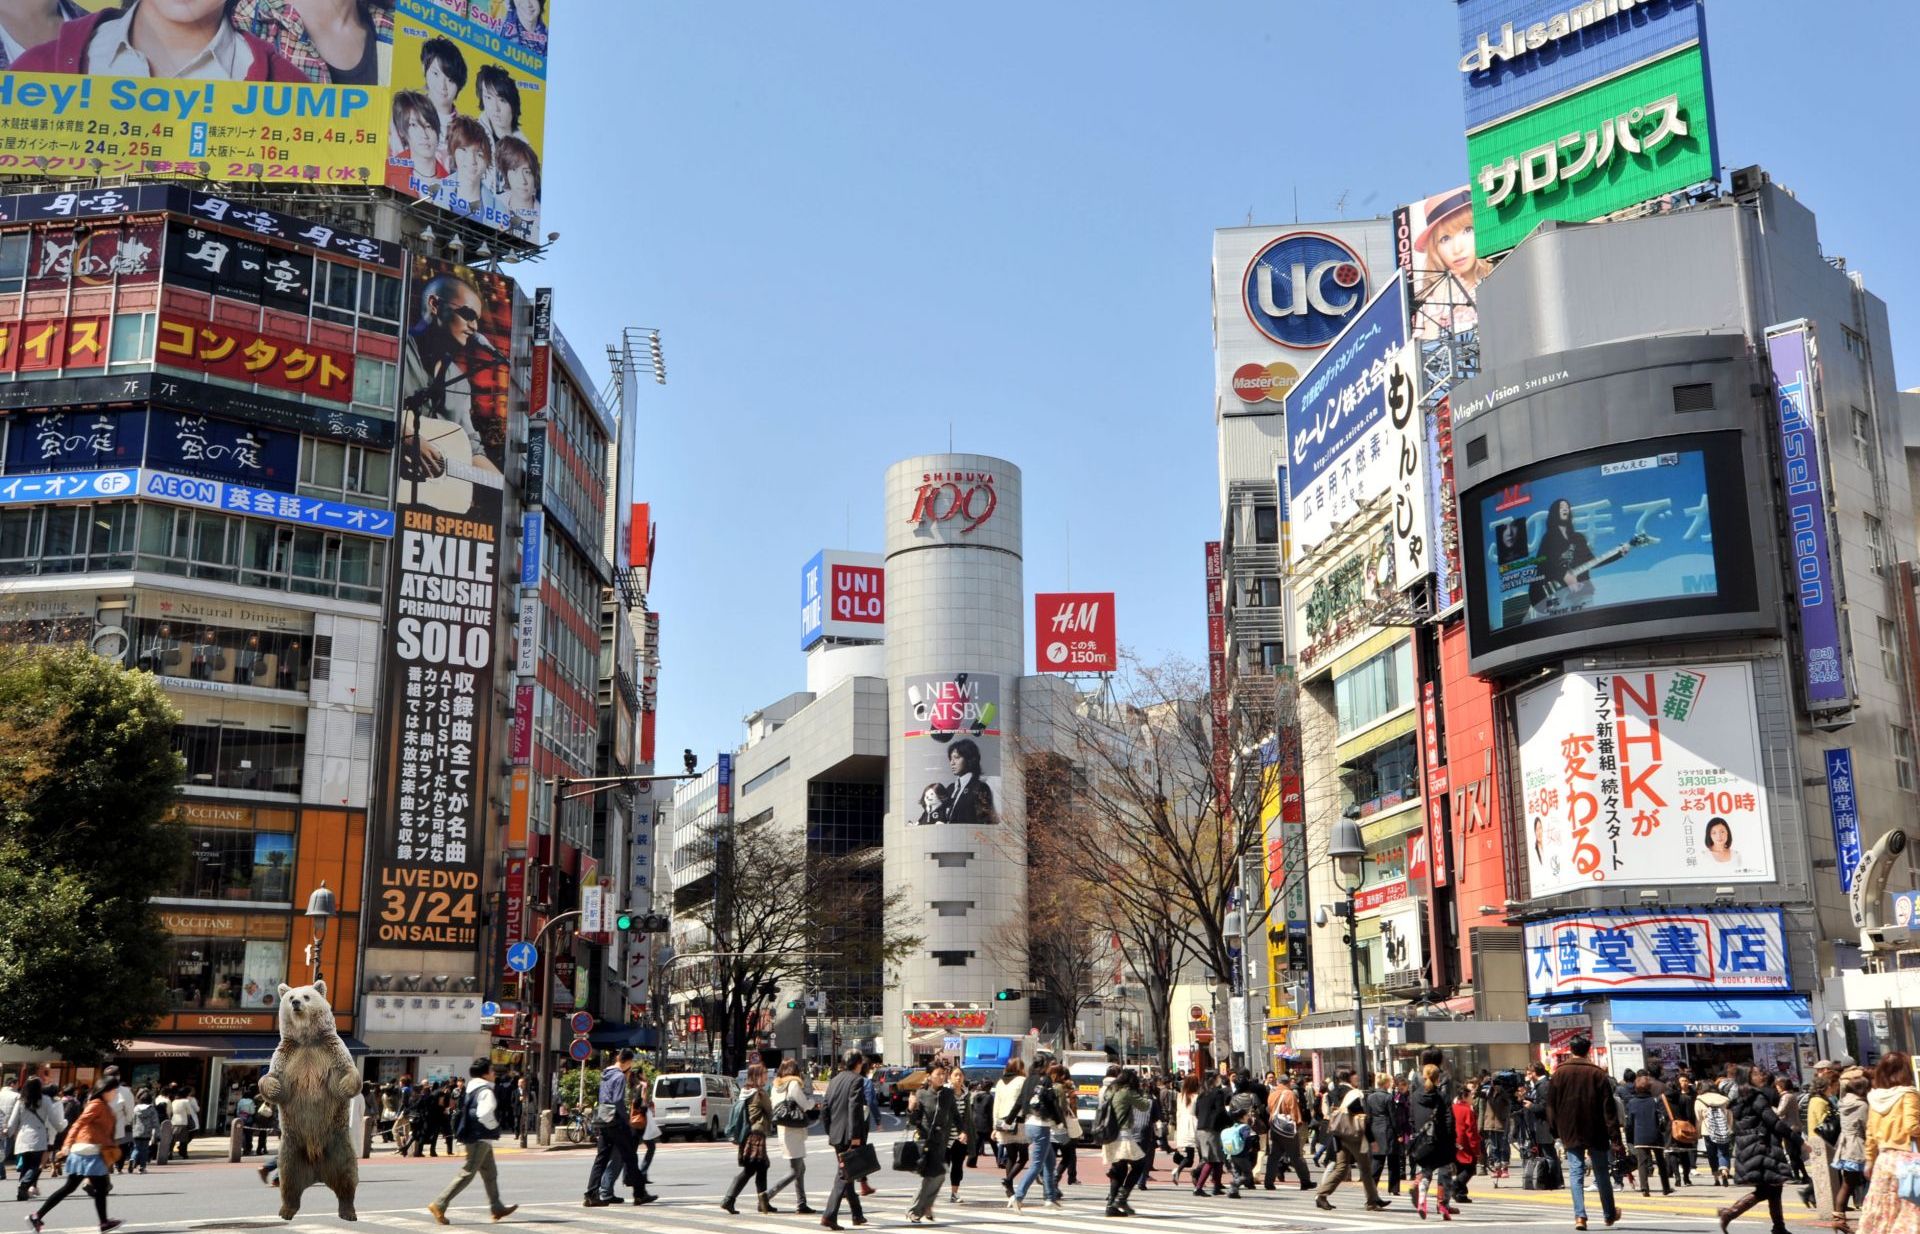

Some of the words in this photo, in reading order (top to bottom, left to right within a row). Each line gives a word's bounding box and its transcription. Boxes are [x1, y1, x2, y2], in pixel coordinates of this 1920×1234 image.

[503, 44, 543, 71] JUMP
[110, 80, 214, 120] Say!
[232, 85, 369, 118] JUMP
[1478, 93, 1687, 208] サロンパス
[188, 228, 205, 240] 9F
[160, 321, 347, 387] コンタクト
[124, 381, 139, 395] 7F
[161, 383, 177, 397] 7F
[1453, 398, 1484, 422] Mighty
[1485, 382, 1520, 409] Vision
[1525, 370, 1569, 391] SHIBUYA
[1777, 370, 1818, 498] Taisei
[3, 475, 88, 500] イーオン
[101, 476, 123, 492] 6F
[147, 474, 216, 504] AEON
[923, 472, 994, 484] SHIBUYA
[1303, 428, 1392, 523] 広告用不燃素
[228, 487, 389, 531] 英会話イーオン
[906, 482, 997, 534] 109
[404, 511, 433, 531] EXH
[435, 516, 495, 542] SPECIAL
[401, 529, 494, 583] EXILE
[1792, 503, 1824, 608] neon
[399, 572, 493, 609] ATSUSHI
[806, 566, 818, 602] THE
[838, 571, 877, 594] UNI
[180, 602, 233, 621] Natural
[240, 610, 287, 628] Dining
[398, 598, 462, 622] PREMIUM
[463, 607, 491, 627] LIVE
[838, 596, 881, 618] QLO
[1051, 601, 1099, 634] H&M
[396, 617, 490, 669] SOLO
[1070, 640, 1097, 651] この先
[1070, 651, 1107, 665] 150m
[517, 687, 532, 697] 5F
[926, 681, 980, 702] NEW!
[1662, 671, 1698, 723] 速報
[913, 701, 988, 724] GATSBY
[396, 666, 422, 861] 番組では未放送楽曲を収録
[414, 668, 438, 861] カヴァー曲がラインナップ
[446, 671, 476, 865] 収録曲全てが名曲
[1612, 673, 1668, 838] NHKが
[1594, 675, 1624, 871] ドラマ新番組、続々スタート
[1560, 732, 1606, 882] 変わる。
[1680, 790, 1756, 815] よる10時
[382, 866, 430, 888] LIVE
[432, 870, 479, 890] DVD
[381, 889, 477, 925] 3/24
[379, 925, 407, 942] ON
[409, 926, 476, 944] SALE!!!
[1533, 924, 1768, 980] 大盛堂書店
[1721, 976, 1745, 985] BOOKS
[1748, 976, 1783, 985] TAISEIDO
[199, 1015, 254, 1026] L'OCCITANE
[1683, 1023, 1741, 1035] TAISEIDO
